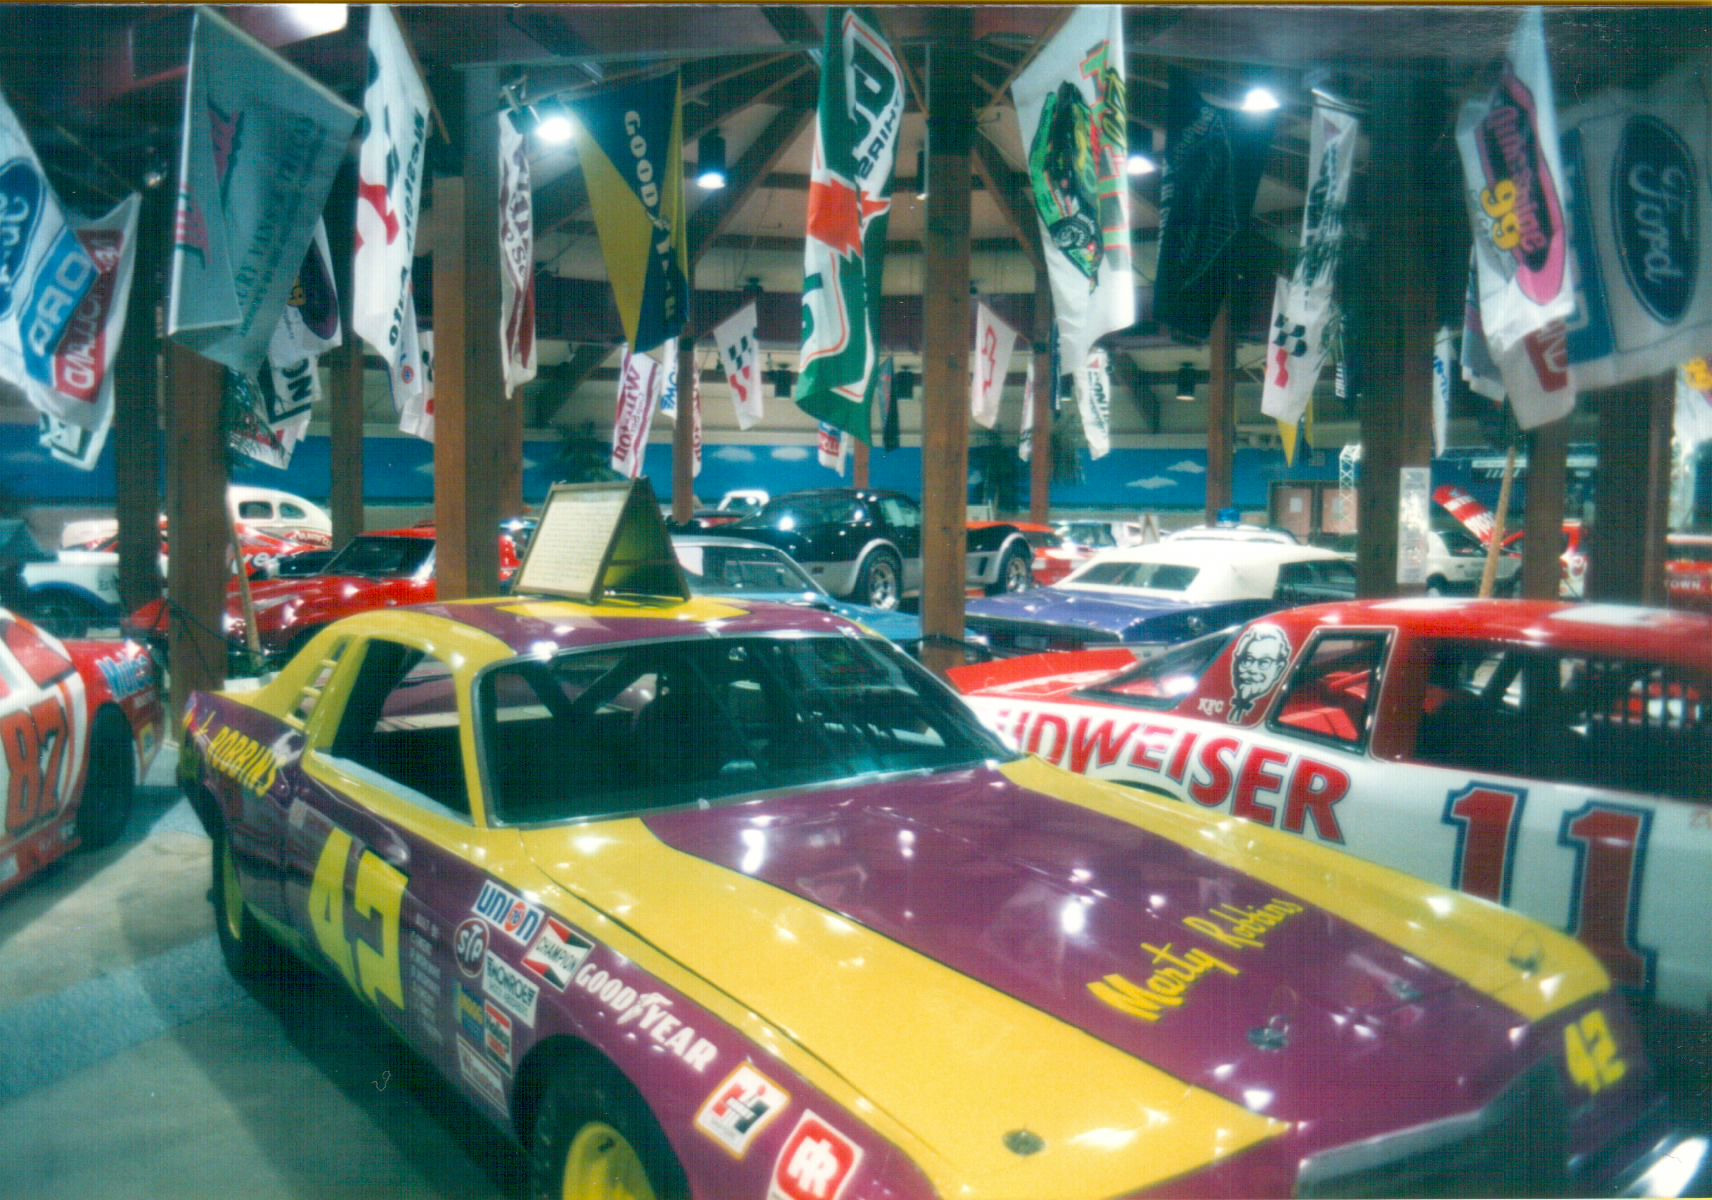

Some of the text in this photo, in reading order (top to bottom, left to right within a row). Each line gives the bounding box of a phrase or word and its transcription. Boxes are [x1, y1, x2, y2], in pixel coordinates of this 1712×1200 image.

[1480, 178, 1522, 251] 99
[1627, 163, 1692, 286] Ford
[1196, 697, 1225, 714] KFC
[0, 697, 68, 834] 87
[308, 826, 409, 1012] 42
[1182, 897, 1304, 950] Robbins
[1442, 780, 1660, 1003] 11
[456, 922, 485, 965] STP
[487, 955, 537, 1006] MONROE
[534, 936, 580, 975] CHAMPION
[1086, 941, 1241, 1022] Marty
[575, 961, 719, 1073] GOODYEAR
[1564, 1009, 1627, 1096] 42
